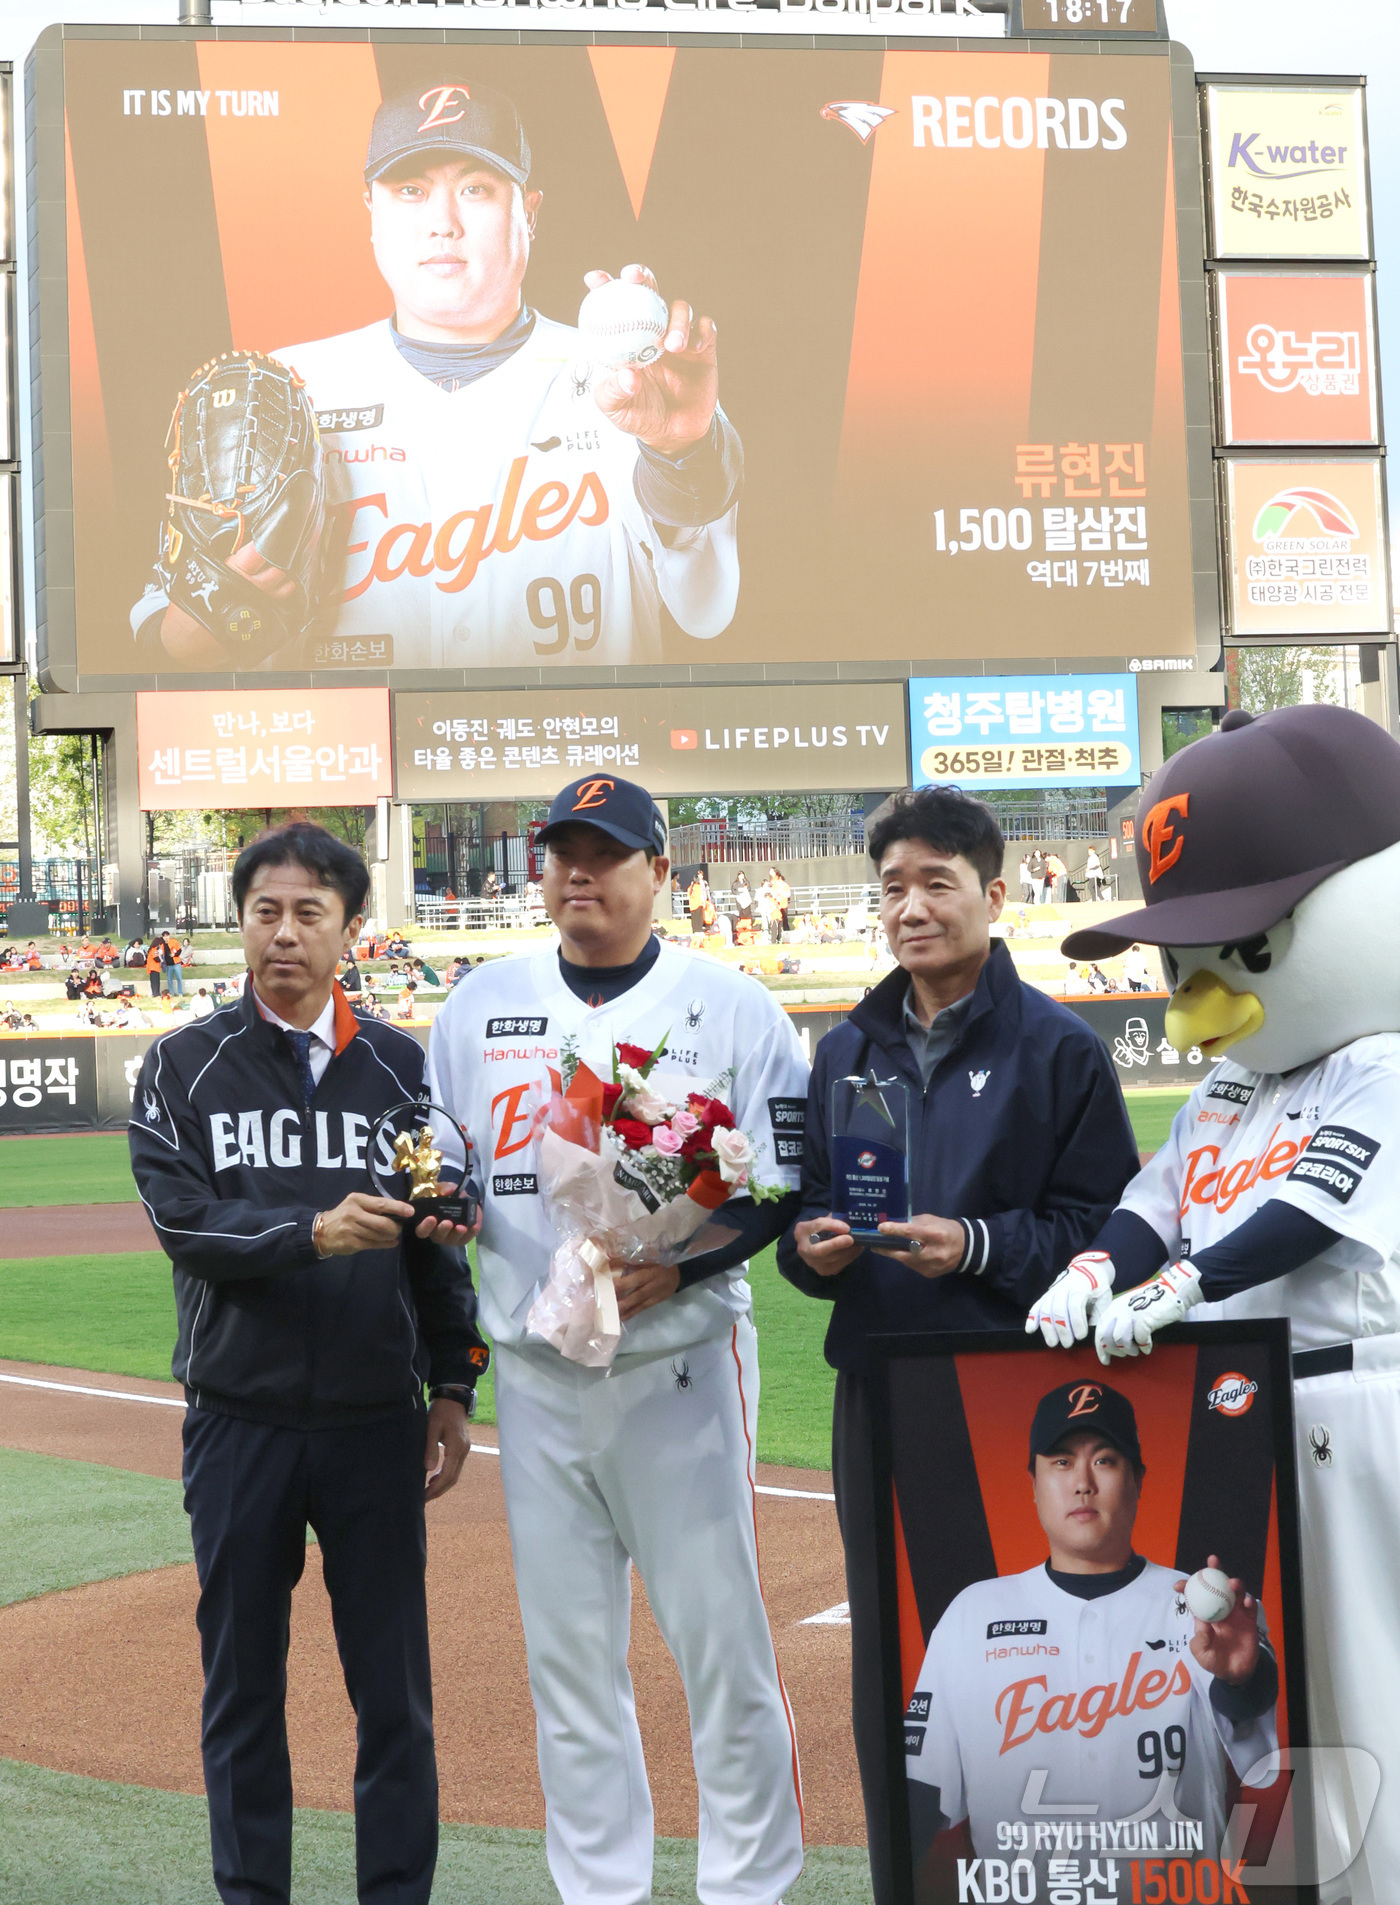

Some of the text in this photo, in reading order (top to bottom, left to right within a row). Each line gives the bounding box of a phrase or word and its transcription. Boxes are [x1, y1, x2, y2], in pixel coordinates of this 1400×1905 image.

[123, 89, 279, 117] IT IS MY TURN
[911, 95, 1128, 150] RECORDS
[1228, 133, 1347, 172] K-water
[1231, 186, 1351, 222] 한국수자원공사
[1304, 373, 1355, 391] 상품권
[318, 408, 376, 429] 화생명
[566, 430, 599, 442] LIFE
[567, 441, 601, 451] PLUS
[1014, 442, 1147, 498] 류현진
[338, 456, 609, 603] Eagles
[933, 506, 1148, 556] 1,500 탈삼진
[1266, 540, 1348, 550] GREEN SOLAR
[1026, 558, 1150, 588] 역대 7번째
[1251, 584, 1369, 603] 태양광 시공 전문
[526, 573, 602, 656] 99
[315, 640, 387, 663] 한화손보
[1142, 658, 1193, 671] SAMIK
[923, 688, 1126, 736] 청주탑병원
[705, 724, 890, 750] LIFEPLUS TV
[148, 743, 382, 785] 센트럴서울안과
[414, 743, 640, 771] 타율 좋은 콘텐츠 큐레이션
[933, 750, 1015, 775] 365일!
[491, 1019, 542, 1034] 한화생명
[484, 1046, 558, 1063] Hanwha
[671, 1048, 698, 1059] LIFE
[671, 1054, 698, 1065] PLUS
[0, 1057, 79, 1108] 명작
[209, 1108, 399, 1177] EAGLES
[1311, 1136, 1371, 1162] SPORTSIX
[495, 1176, 534, 1192] 한화손보
[1293, 1161, 1354, 1194] 잡코리아
[1208, 1379, 1258, 1409] Eagles
[992, 1621, 1041, 1636] 한화생명
[985, 1642, 1060, 1663] Hanwha
[995, 1651, 1191, 1757] Eagles
[1136, 1724, 1187, 1780] 99
[997, 1821, 1204, 1851] 99 RYU HYUN JIN
[956, 1858, 1251, 1905] KBO 통산 1500K
